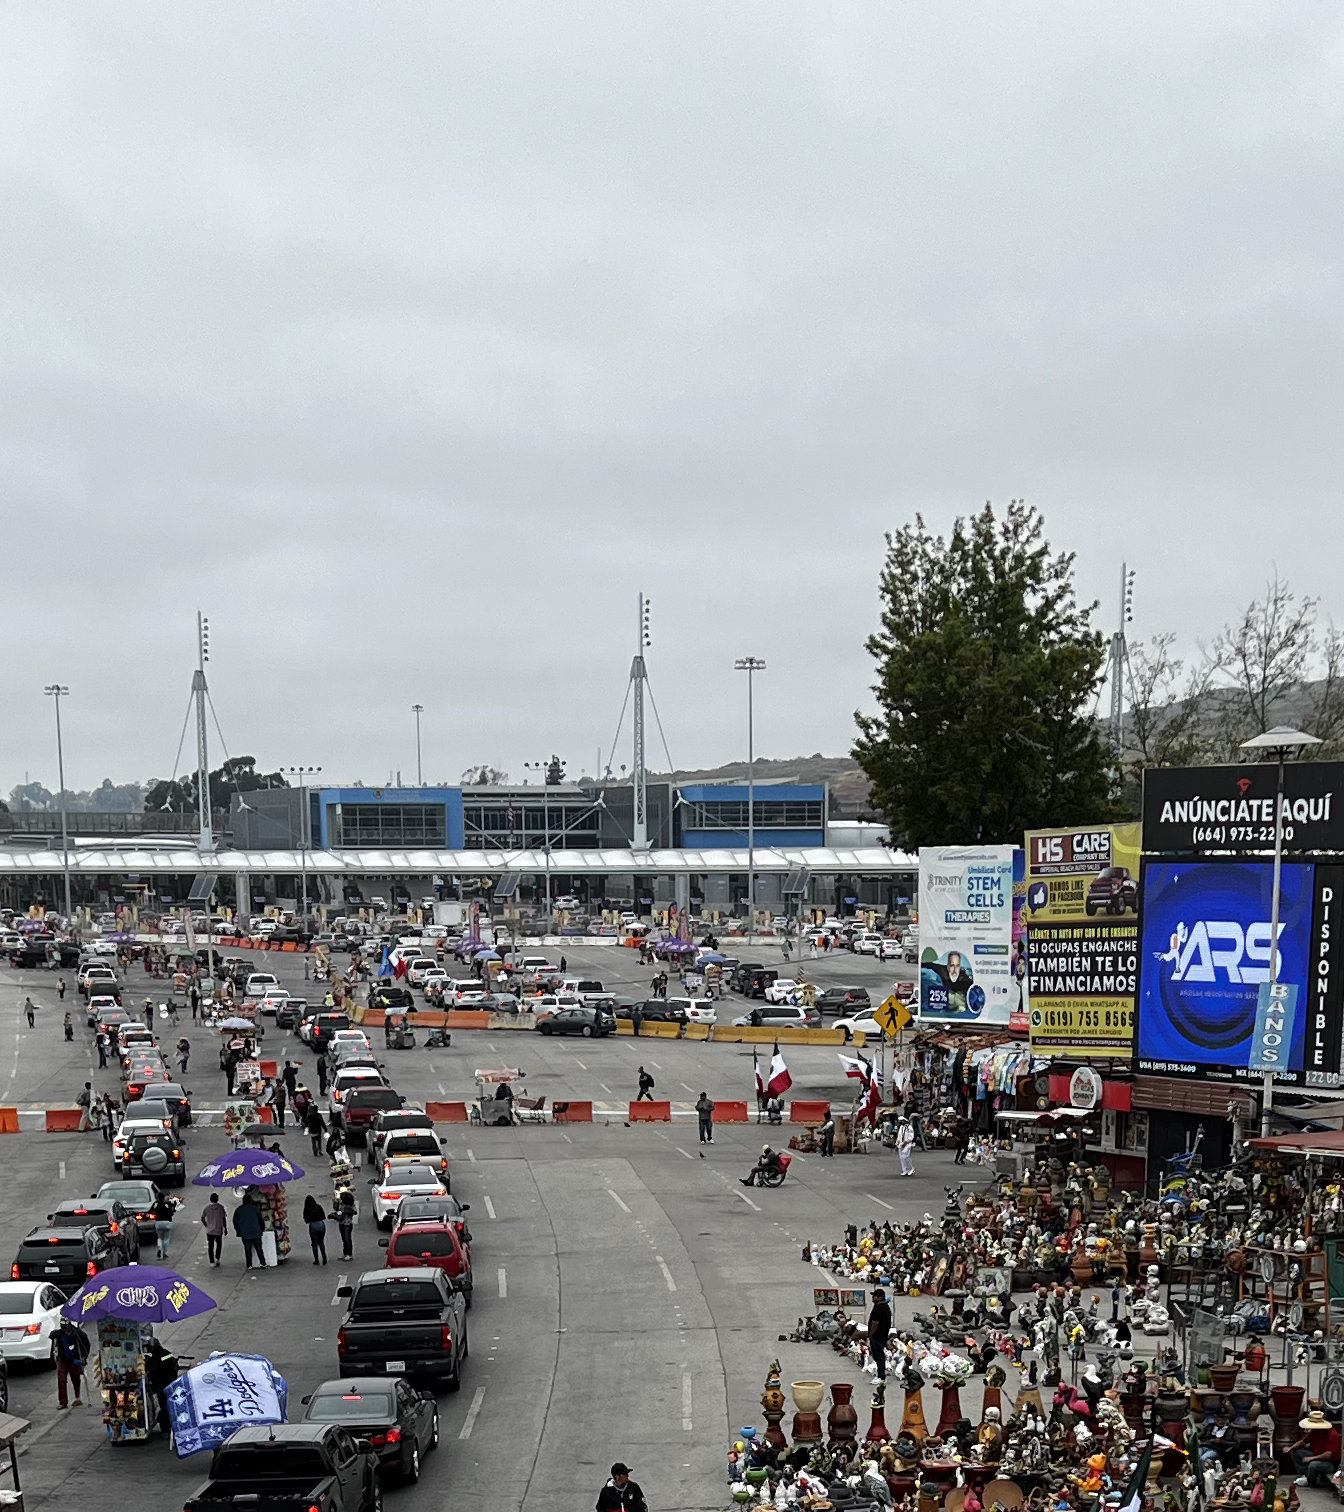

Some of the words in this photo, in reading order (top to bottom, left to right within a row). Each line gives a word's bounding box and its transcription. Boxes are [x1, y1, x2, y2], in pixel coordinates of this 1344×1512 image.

[1160, 795, 1273, 823] ANÚNCIATE
[1281, 793, 1333, 824] AQUÍ
[1193, 826, 1226, 844] (664)
[1038, 837, 1064, 862] HS
[1073, 833, 1109, 853] CARS
[934, 875, 963, 886] TRINITY
[967, 877, 1001, 890] STEM
[967, 893, 1005, 907] CELLS
[946, 911, 990, 922] THERAPIES
[1029, 943, 1038, 954] SI
[1041, 942, 1080, 953] OCUPAS
[1082, 941, 1137, 952] ENGANCHE
[1171, 921, 1286, 984] ARS
[1029, 953, 1091, 972] TAMBIÉN
[1095, 957, 1113, 972] TE
[1118, 956, 1136, 972] LO
[1030, 975, 1136, 992] FINANCIAMOS
[1313, 887, 1334, 1065] DISPONIBLE
[929, 989, 948, 1002] 25%
[1045, 1011, 1072, 1026] (619)
[1078, 1011, 1099, 1026] 755
[1105, 1011, 1134, 1027] 8569
